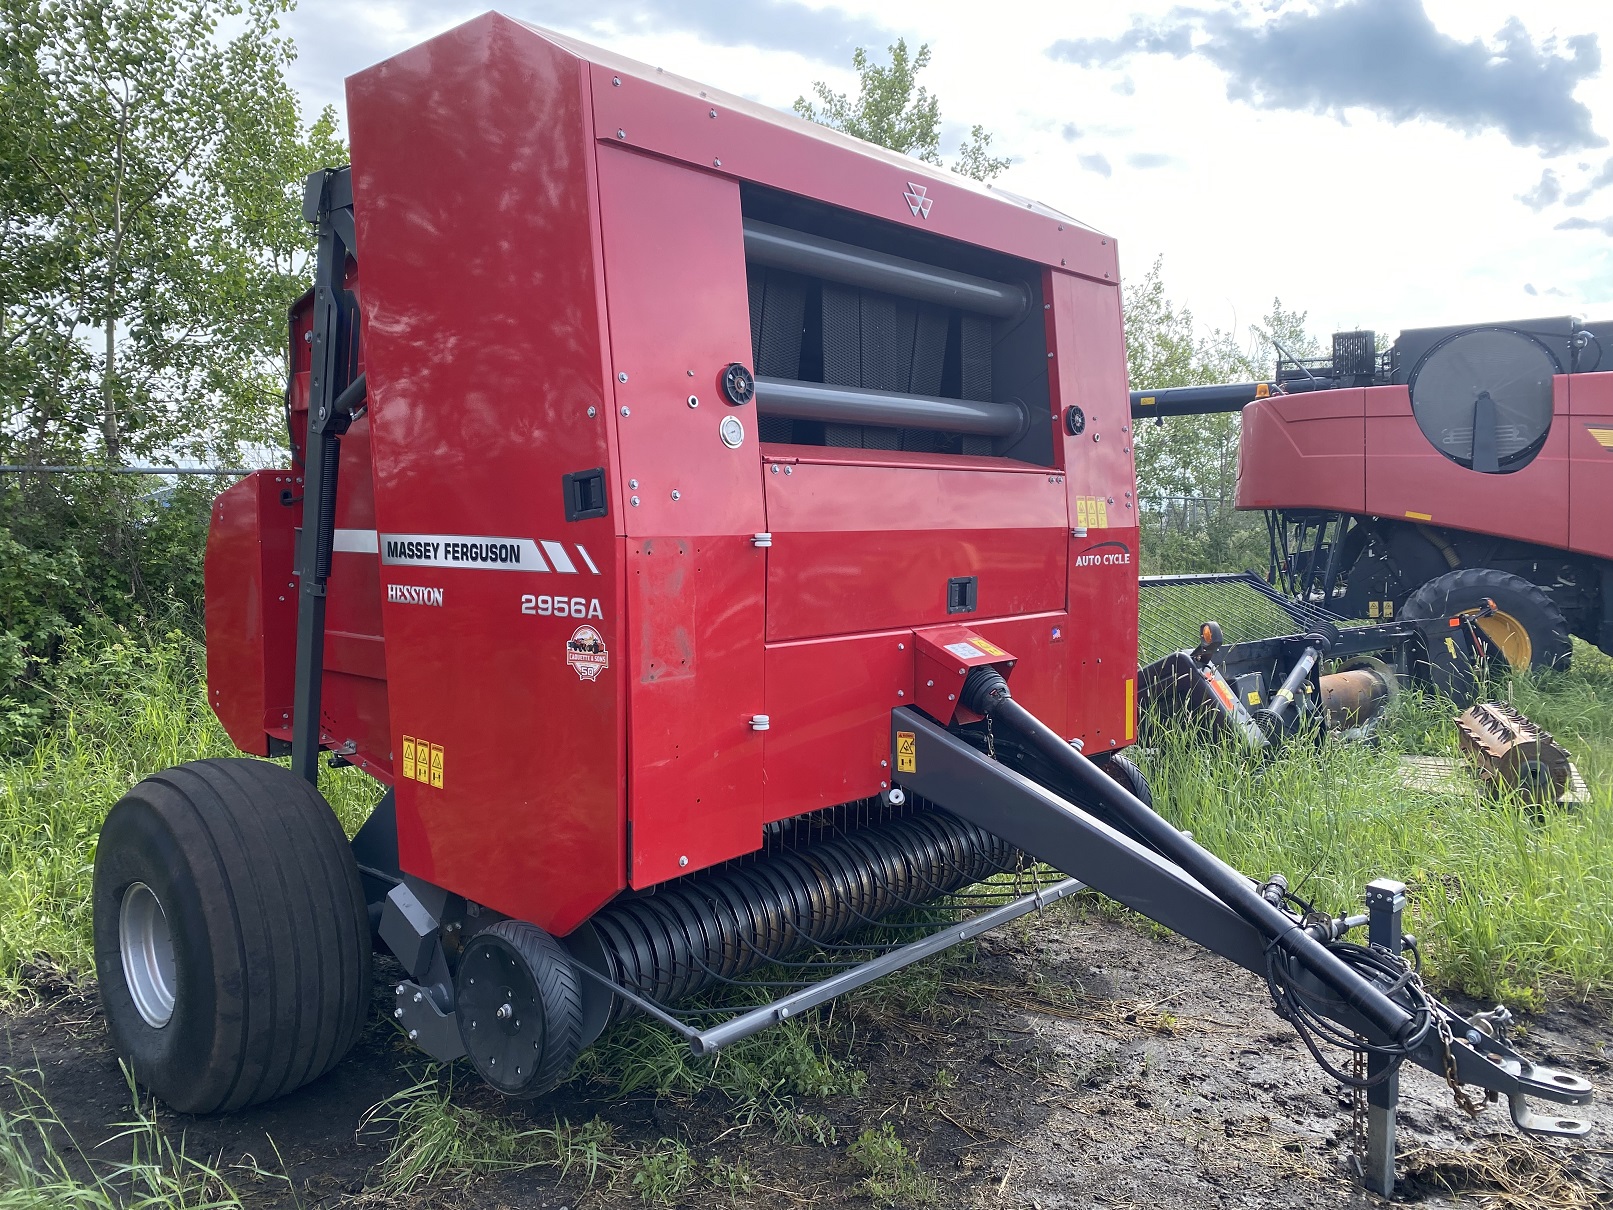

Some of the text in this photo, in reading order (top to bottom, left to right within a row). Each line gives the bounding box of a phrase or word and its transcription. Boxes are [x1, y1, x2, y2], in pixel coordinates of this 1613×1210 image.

[387, 541, 521, 564] MASSEY FERGUSON
[1075, 553, 1130, 567] AUTO CYCLE
[386, 584, 444, 607] HESSTON
[521, 594, 604, 620] 2956A
[594, 655, 606, 663] SONS
[581, 666, 594, 677] 50
